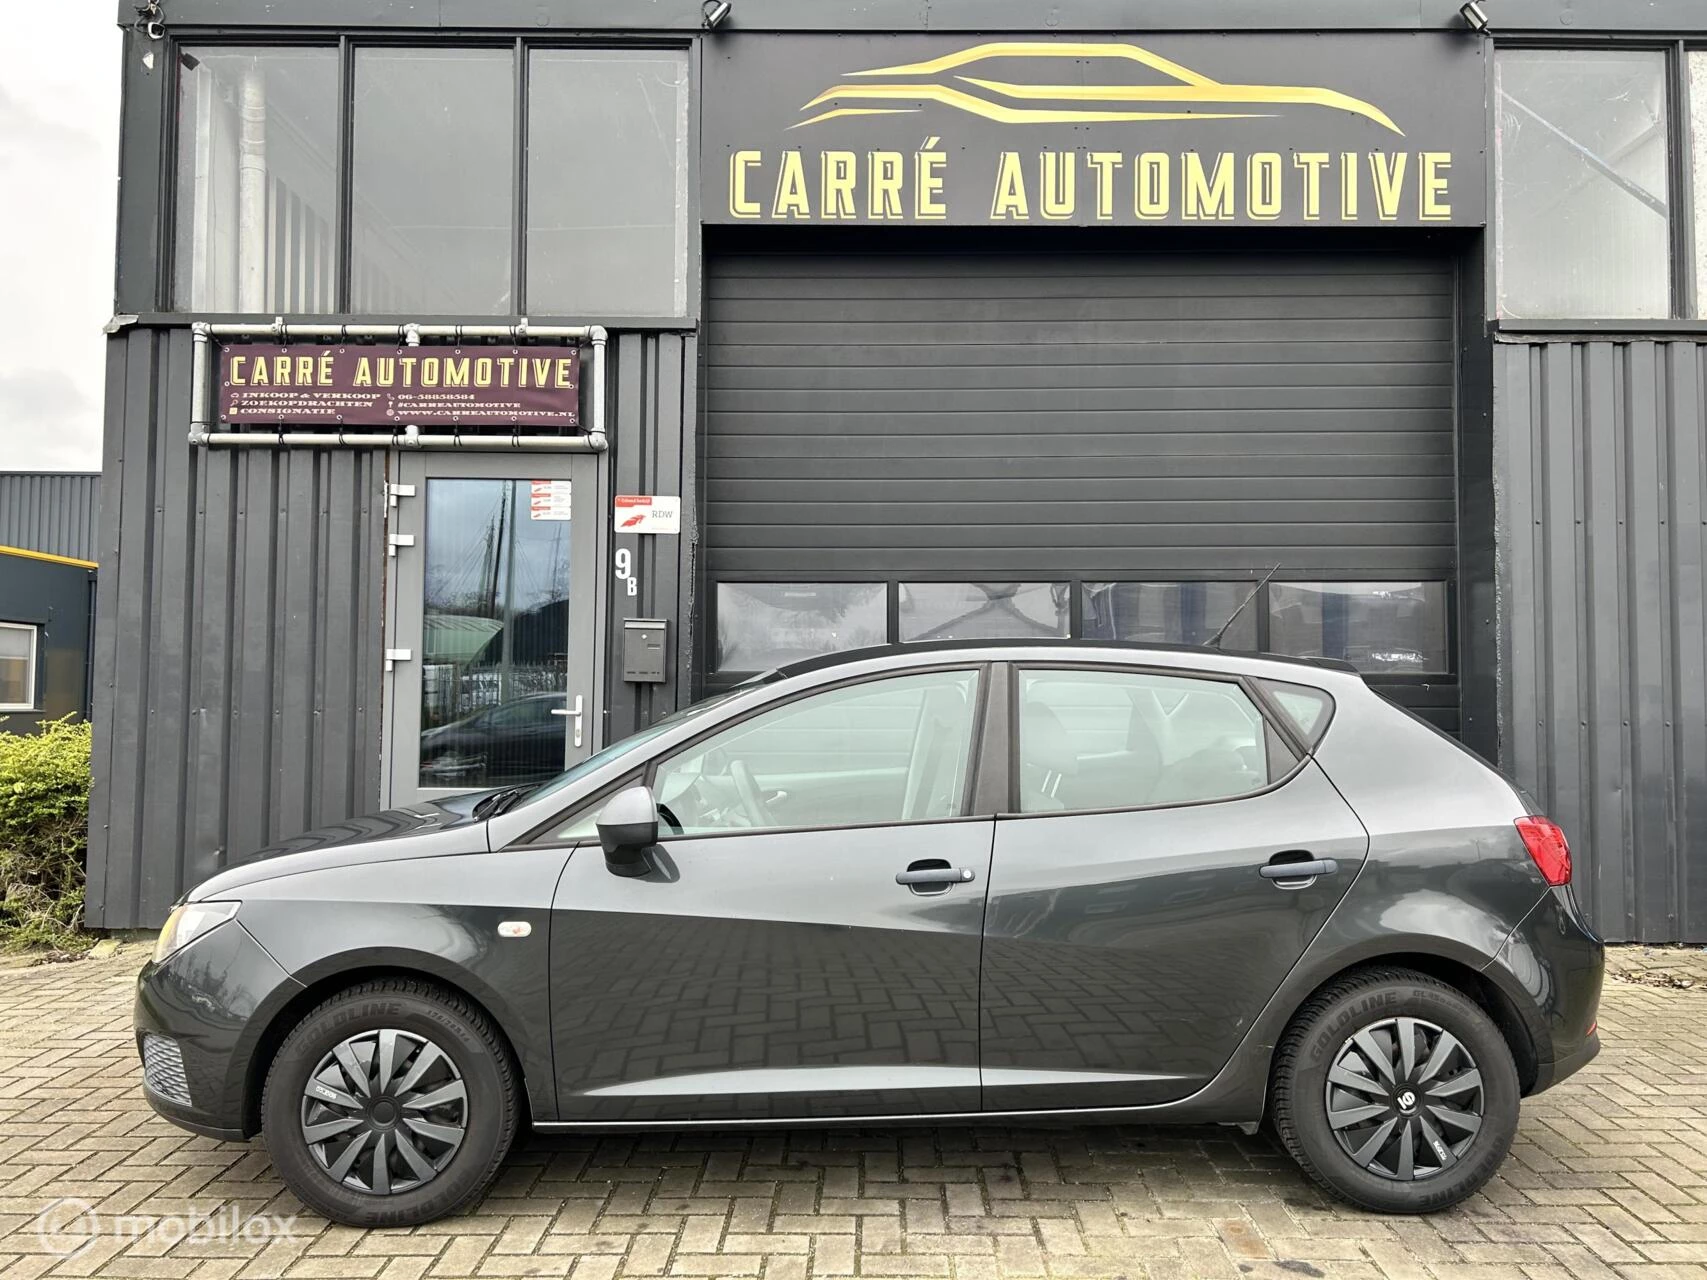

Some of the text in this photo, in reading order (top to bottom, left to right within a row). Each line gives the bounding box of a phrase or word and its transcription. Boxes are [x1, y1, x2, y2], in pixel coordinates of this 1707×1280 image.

[729, 136, 1452, 220] CARRÉ AUTOMOTIVE
[230, 351, 573, 388] CARRÉ AUTOMOTIVE
[652, 510, 674, 519] RDW
[295, 1002, 403, 1054] GOLDLINE
[1311, 991, 1399, 1061] GOLDLINE
